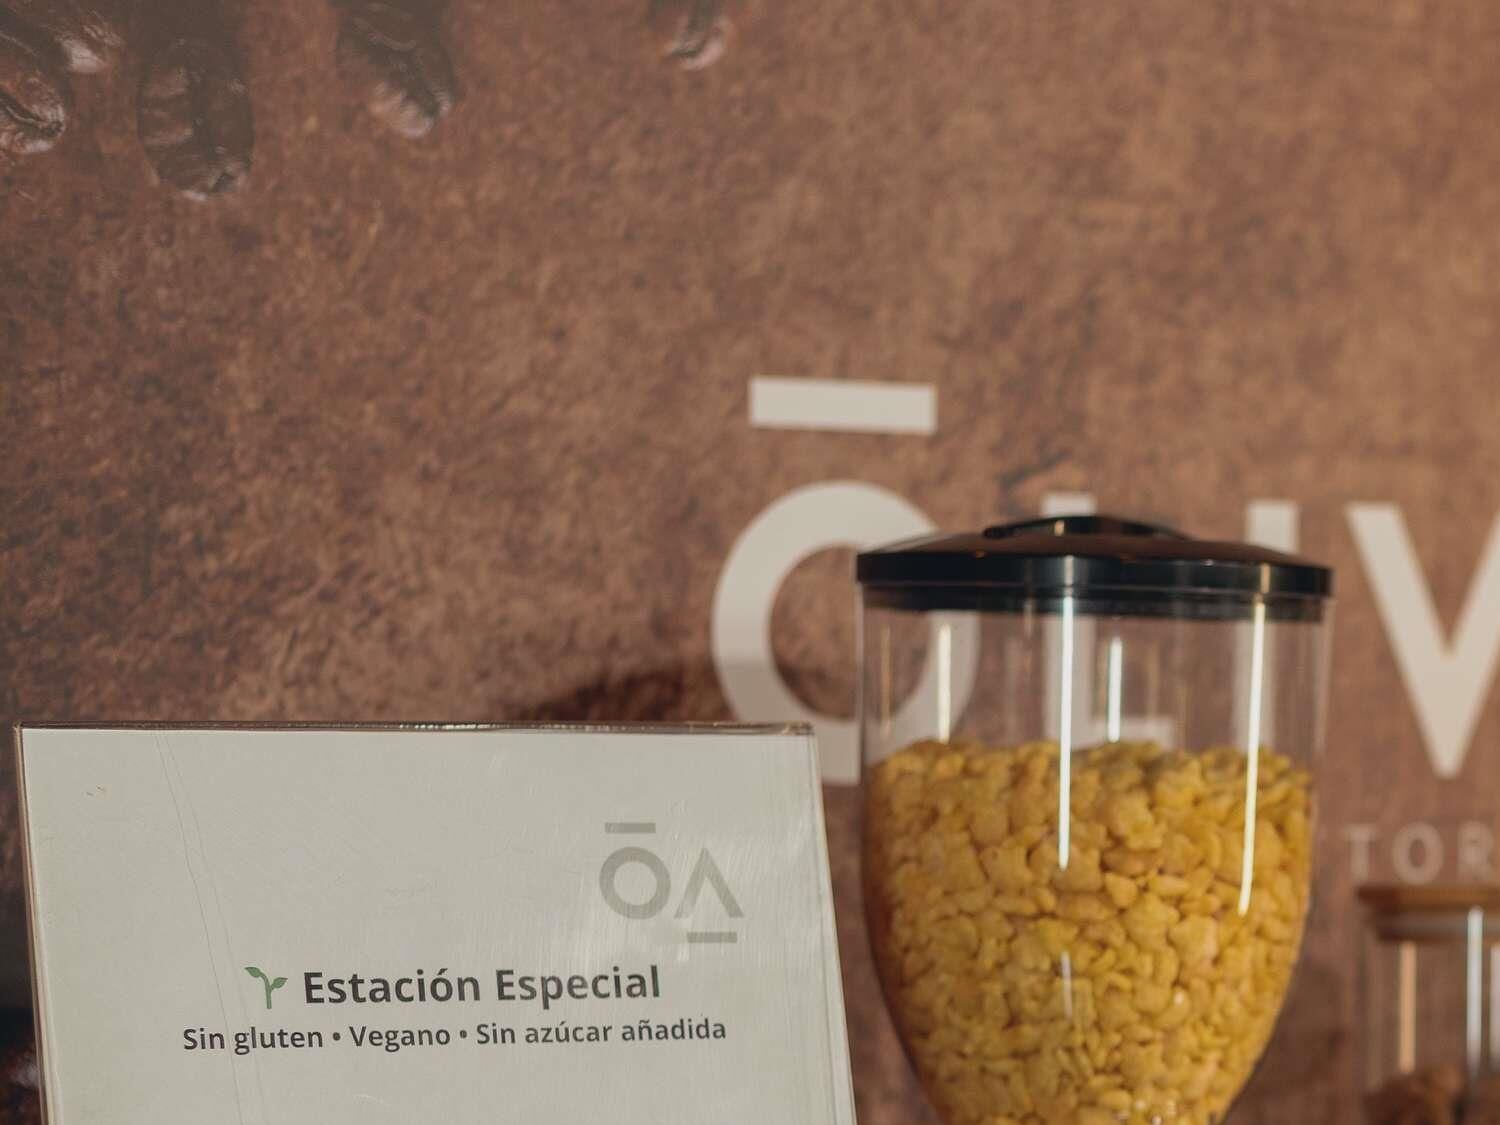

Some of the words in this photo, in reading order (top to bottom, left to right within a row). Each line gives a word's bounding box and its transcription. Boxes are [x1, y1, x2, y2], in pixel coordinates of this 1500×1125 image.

[303, 967, 481, 1005] Estación
[495, 964, 661, 1011] Especial
[183, 1026, 226, 1051] Sin
[232, 1025, 324, 1056] gluten
[348, 1025, 451, 1054] Vegano
[476, 1021, 516, 1046] Sin
[524, 1020, 613, 1044] azúcar
[621, 1014, 727, 1042] añadida
